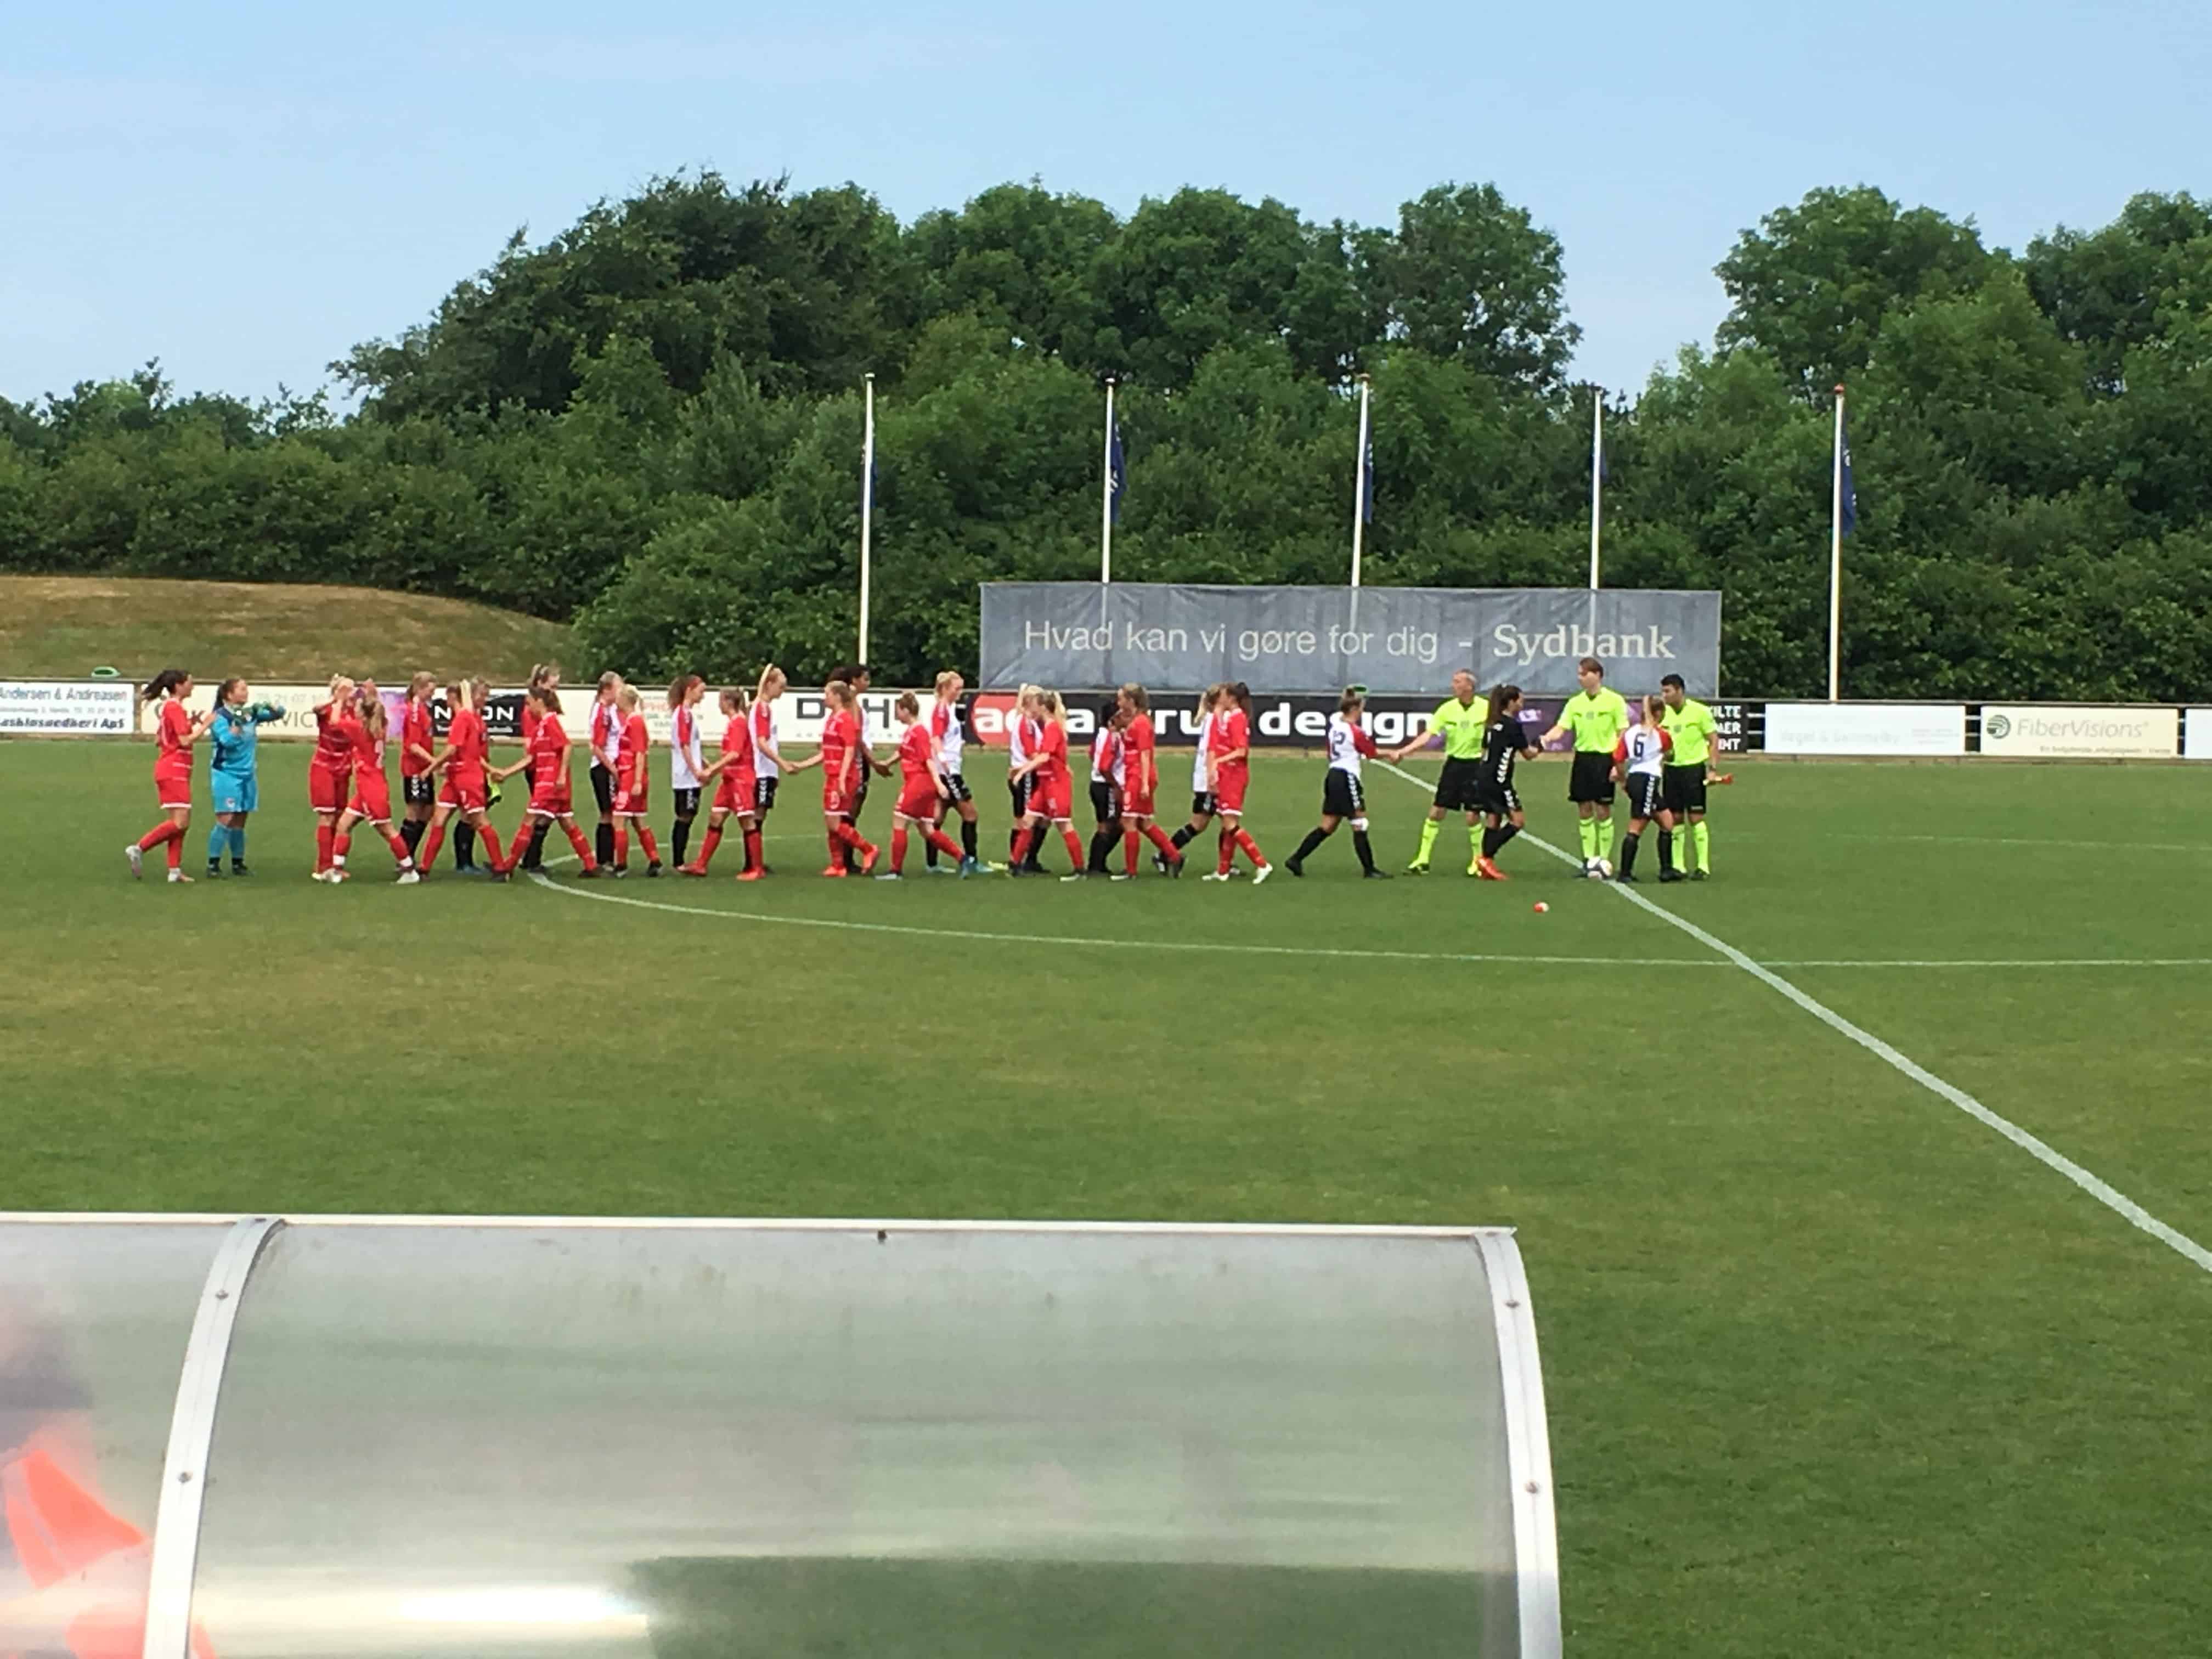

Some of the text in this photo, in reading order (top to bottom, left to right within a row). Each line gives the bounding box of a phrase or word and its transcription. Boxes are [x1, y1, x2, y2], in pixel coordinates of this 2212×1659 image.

[1025, 620, 1113, 651] Hvad
[1127, 622, 1188, 651] kan
[1199, 624, 1225, 652] vi
[1239, 629, 1316, 662] gøre
[1329, 626, 1374, 654] for
[1387, 627, 1437, 662] dig
[1493, 624, 1675, 665] Sydbank
[2017, 718, 2143, 738] FiberVisions
[1634, 732, 1647, 757] 6
